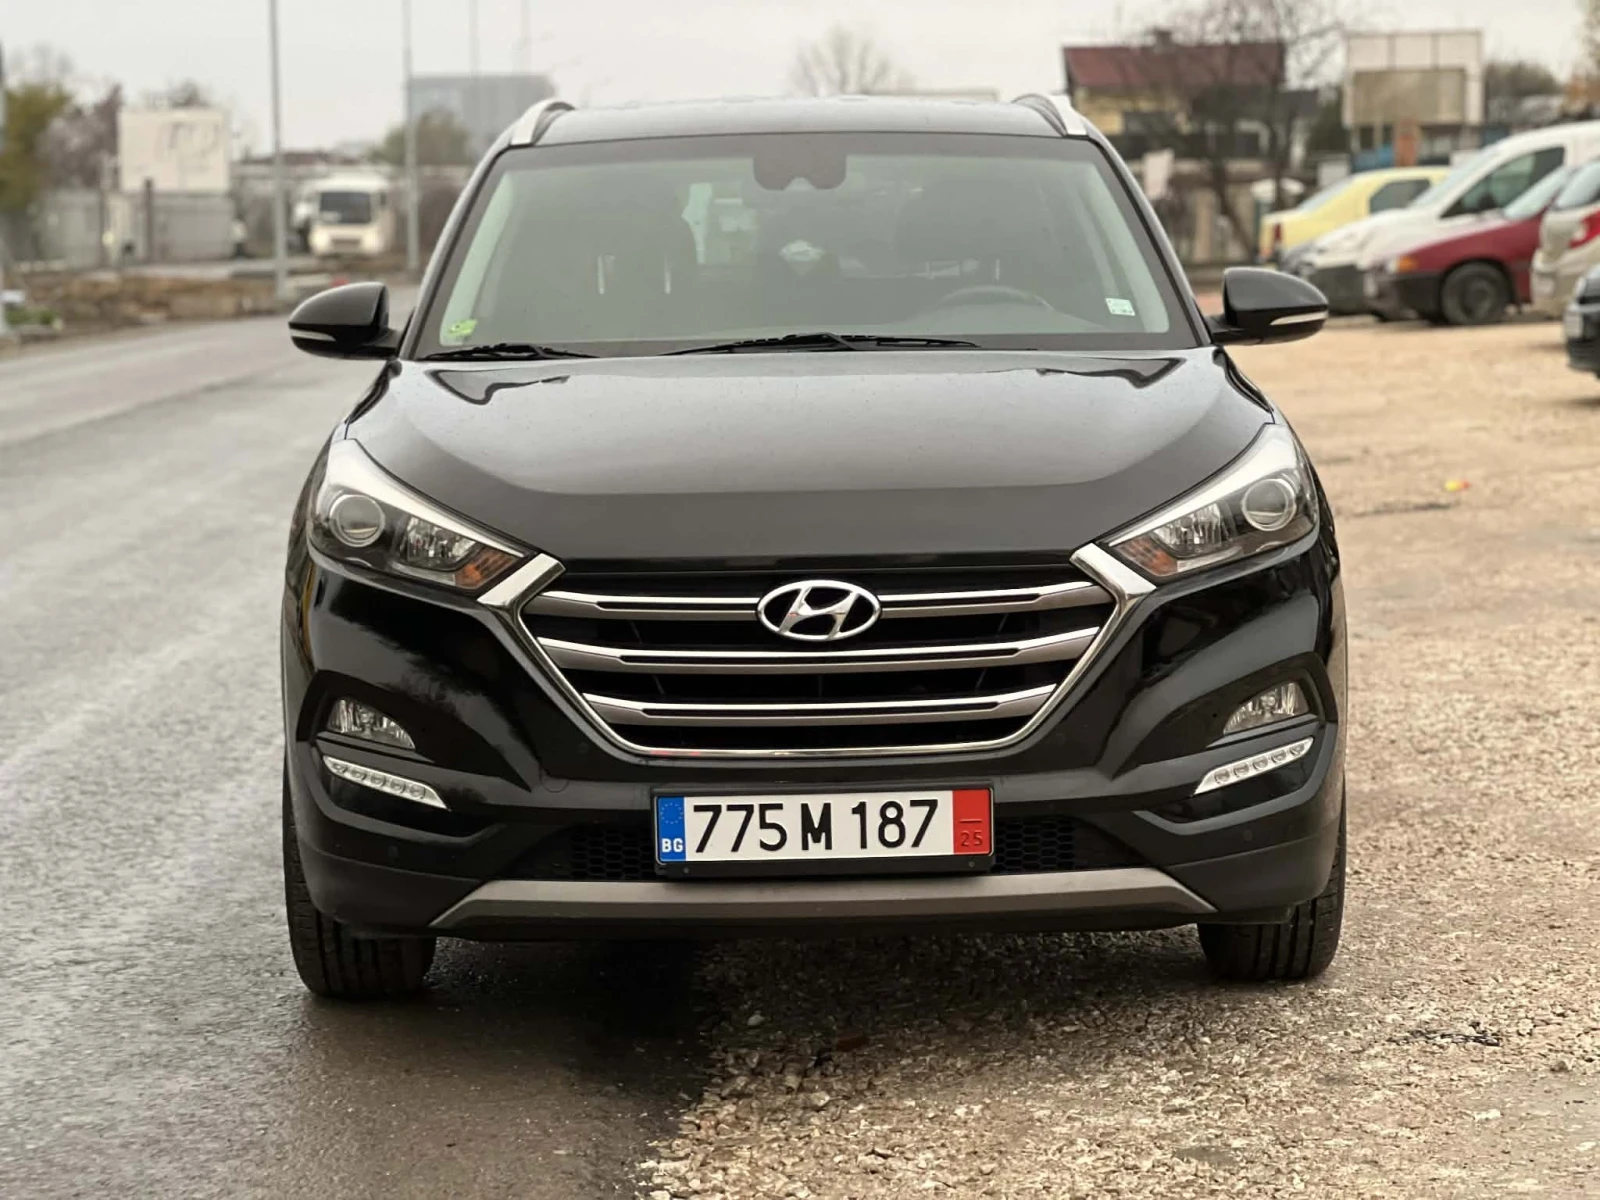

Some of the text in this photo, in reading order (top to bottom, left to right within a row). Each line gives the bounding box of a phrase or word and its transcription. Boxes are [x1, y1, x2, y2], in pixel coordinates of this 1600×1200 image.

[693, 798, 939, 854] 775 M 187
[661, 838, 684, 853] BG
[960, 829, 984, 847] 25
